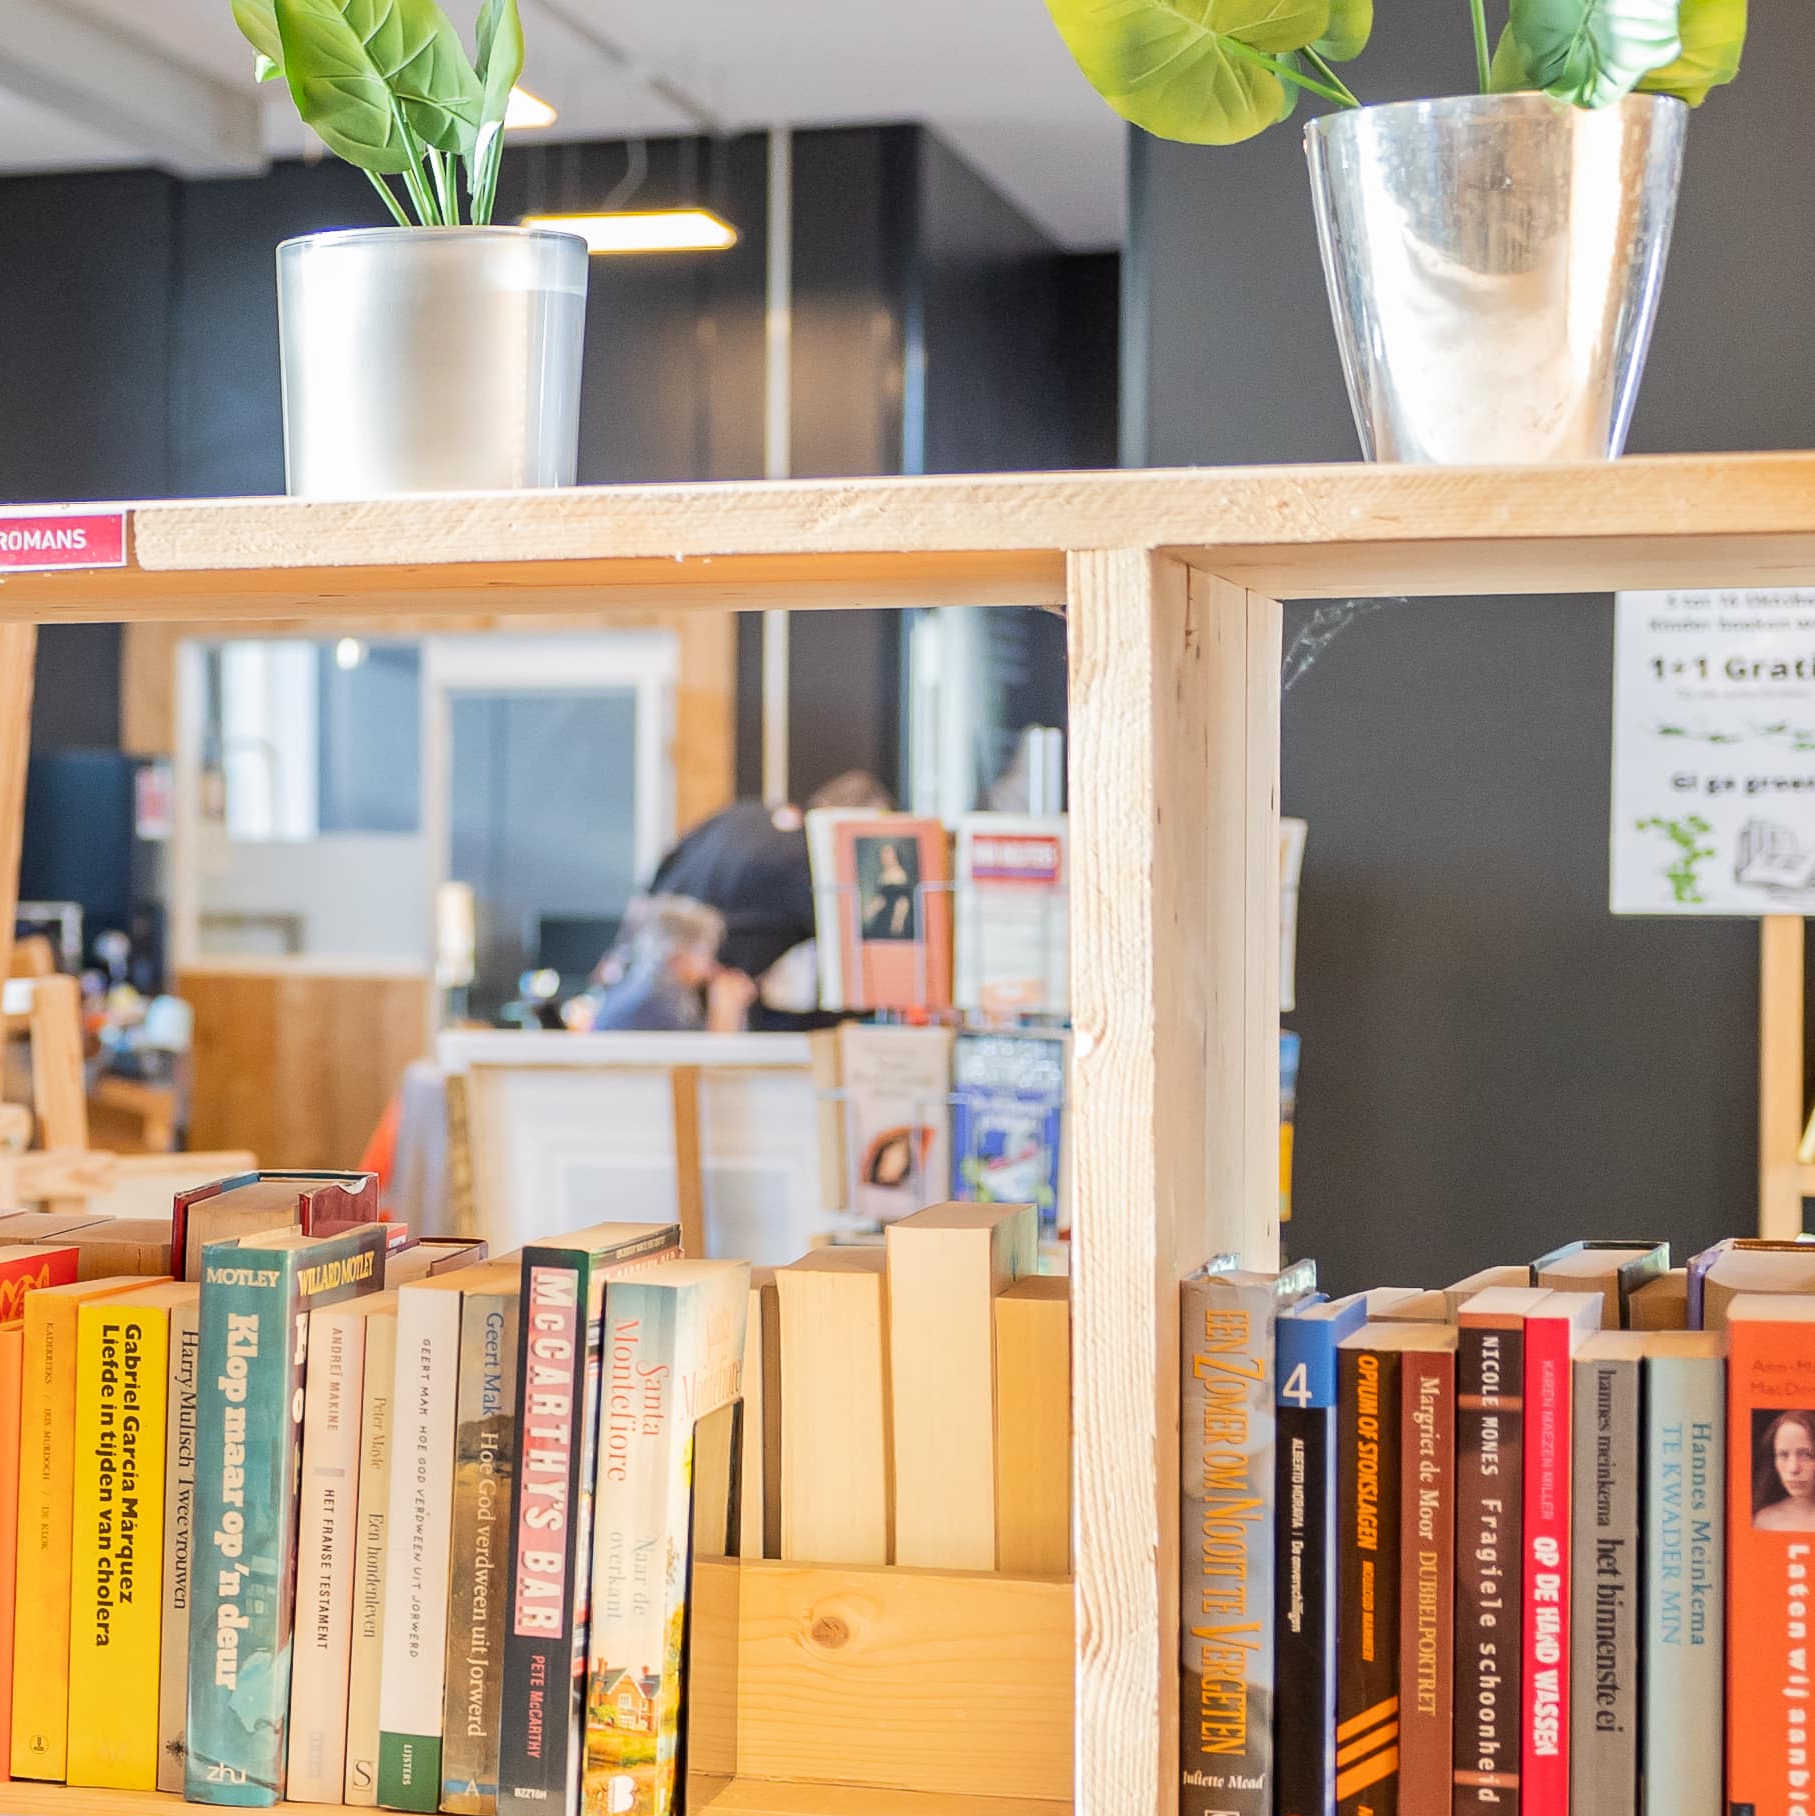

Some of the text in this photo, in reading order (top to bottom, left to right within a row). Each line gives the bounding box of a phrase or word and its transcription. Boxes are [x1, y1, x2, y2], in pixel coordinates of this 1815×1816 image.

[206, 1267, 280, 1287] MOTLEY
[219, 1313, 258, 1402] Klop
[94, 1324, 119, 1646] Liefde in tijden van cholera
[116, 1324, 142, 1603] Gabriel García Márquez
[222, 1408, 246, 1502] maar
[520, 1273, 570, 1629] McCARTHY'S BAR
[214, 1511, 245, 1556] op
[1193, 1309, 1264, 1755] EEN ZOMER OM NOOIT TE VERGETEN
[215, 1603, 246, 1690] deur
[1535, 1537, 1560, 1755] OP DE HAND WASSEN
[1596, 1539, 1623, 1732] het binnenste ei
[527, 1654, 546, 1759] PETE McCARTHY
[401, 1745, 413, 1786] LIJSTERS
